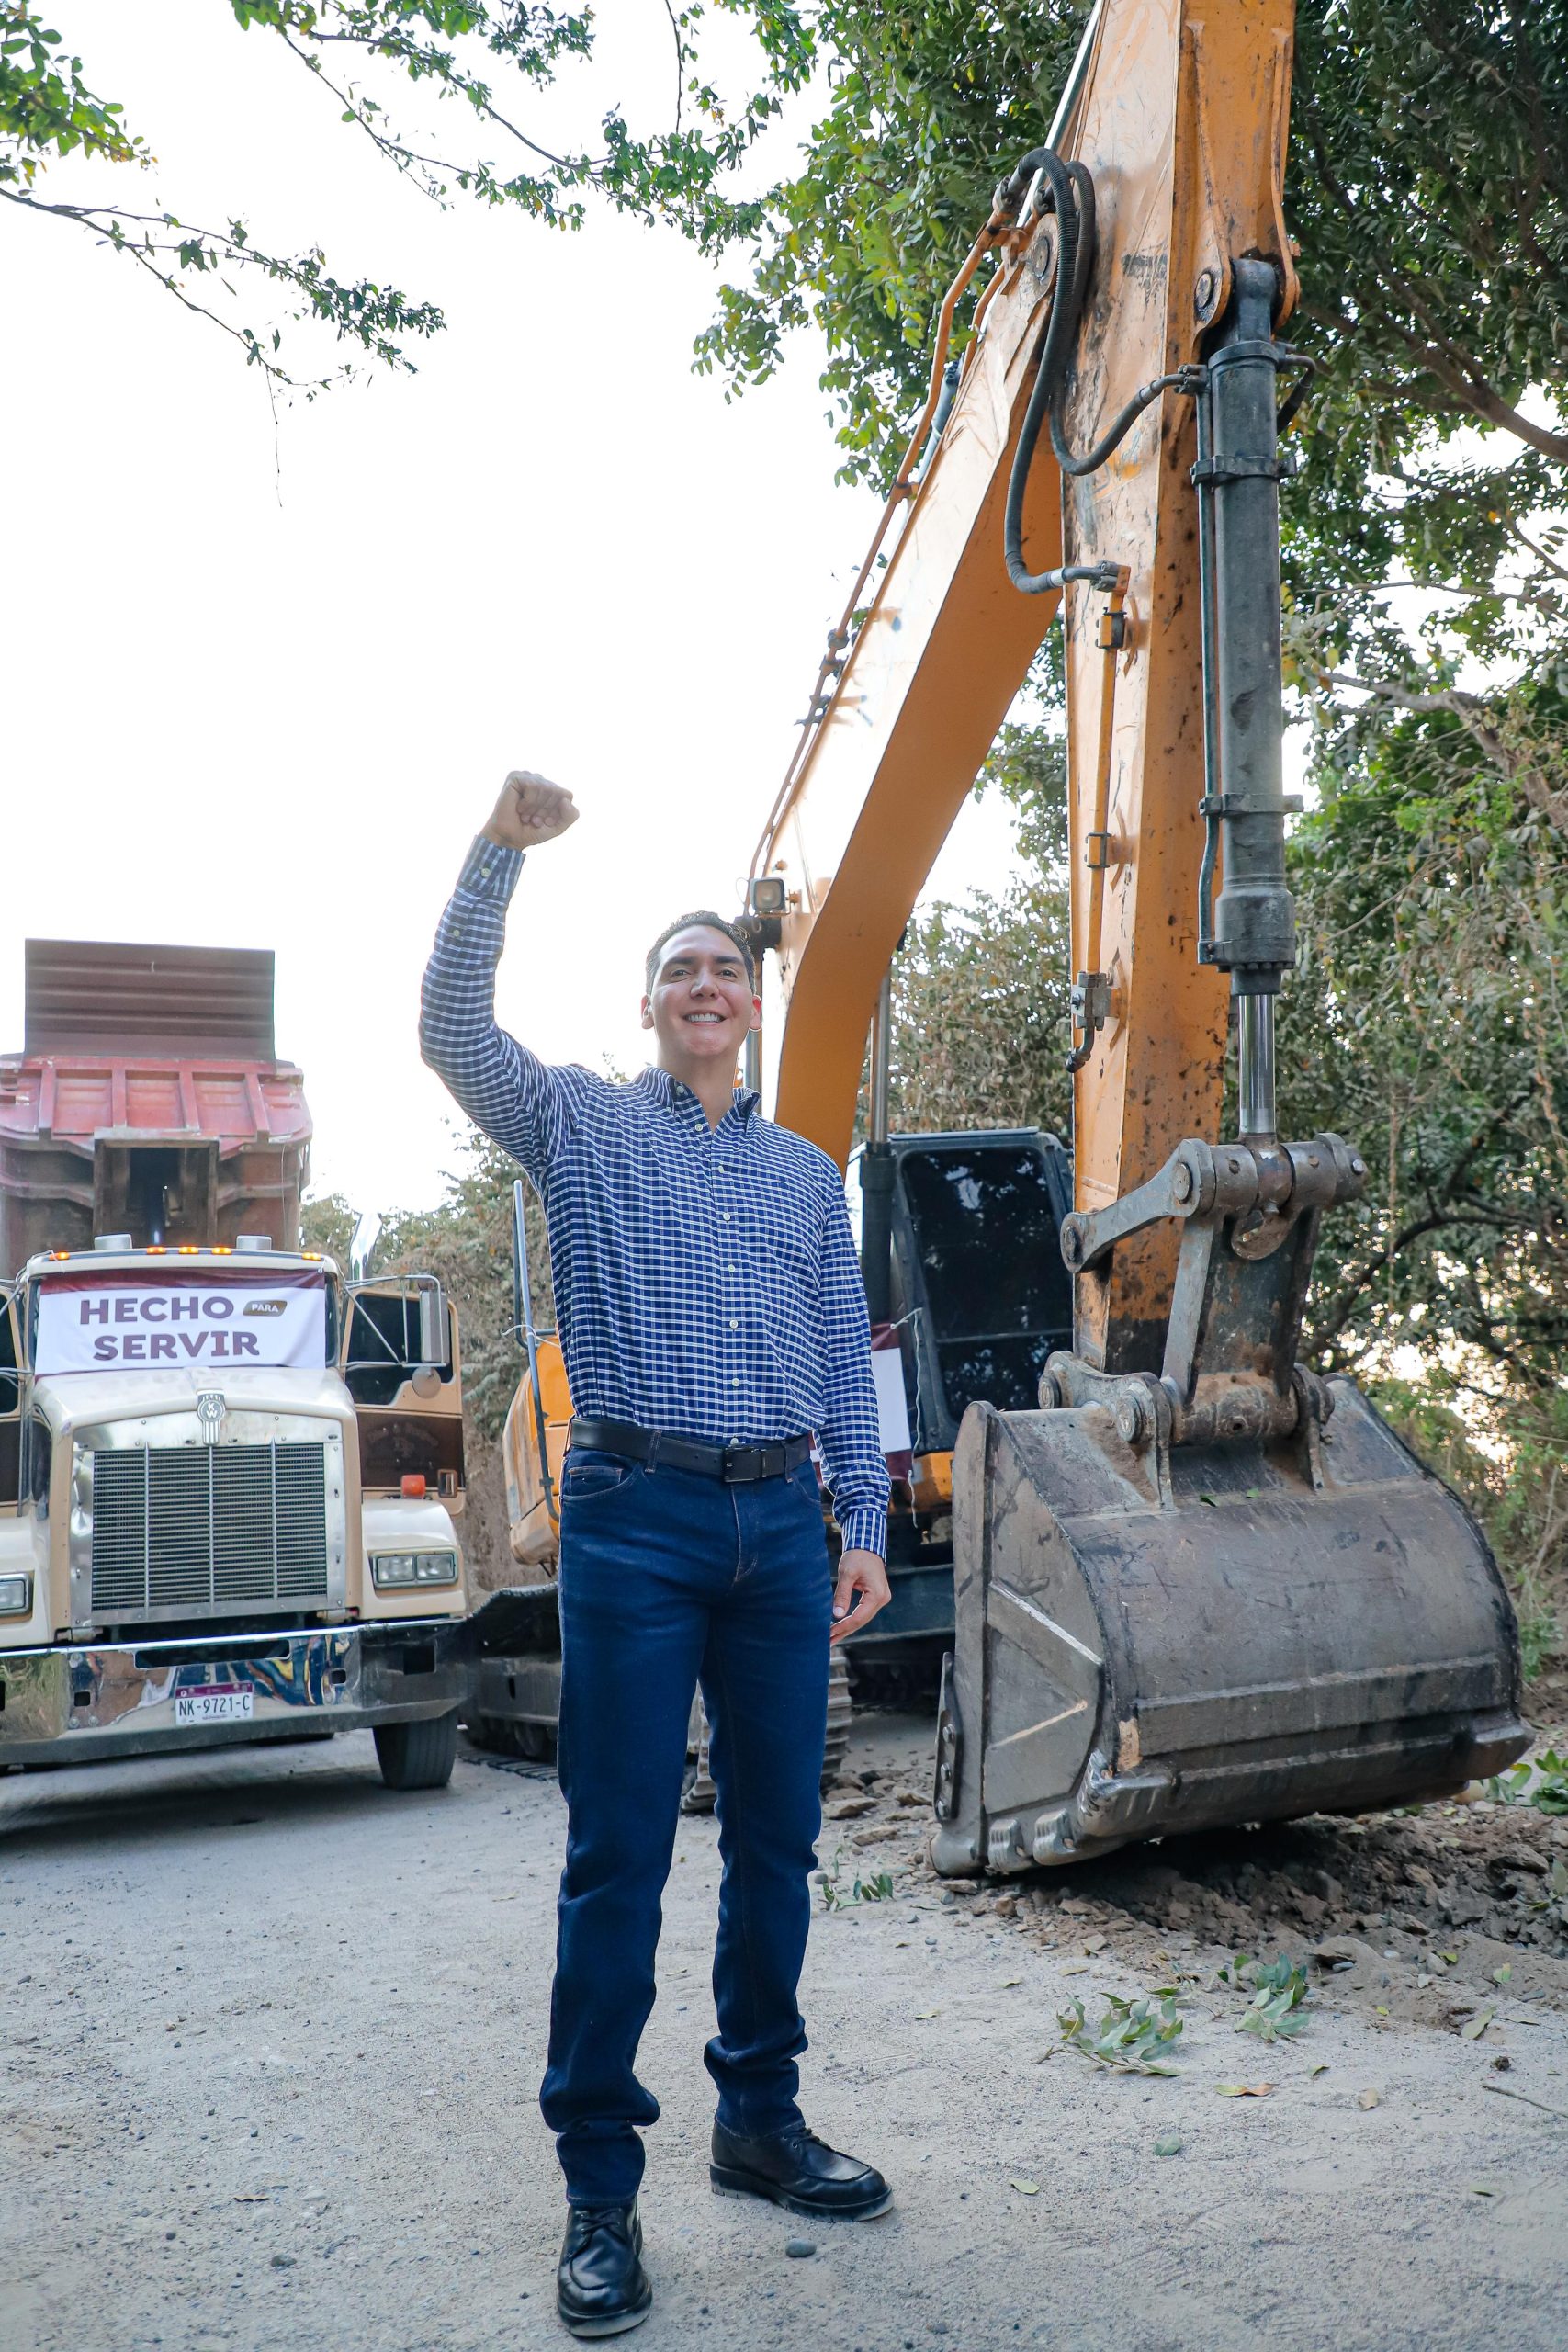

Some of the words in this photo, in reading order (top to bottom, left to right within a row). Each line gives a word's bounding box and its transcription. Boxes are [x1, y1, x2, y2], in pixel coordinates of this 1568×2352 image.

[80, 1296, 234, 1325] HECHO
[251, 1303, 279, 1313] PARA
[93, 1331, 260, 1361] SERVIR
[179, 1694, 251, 1716] NK-9721-C
